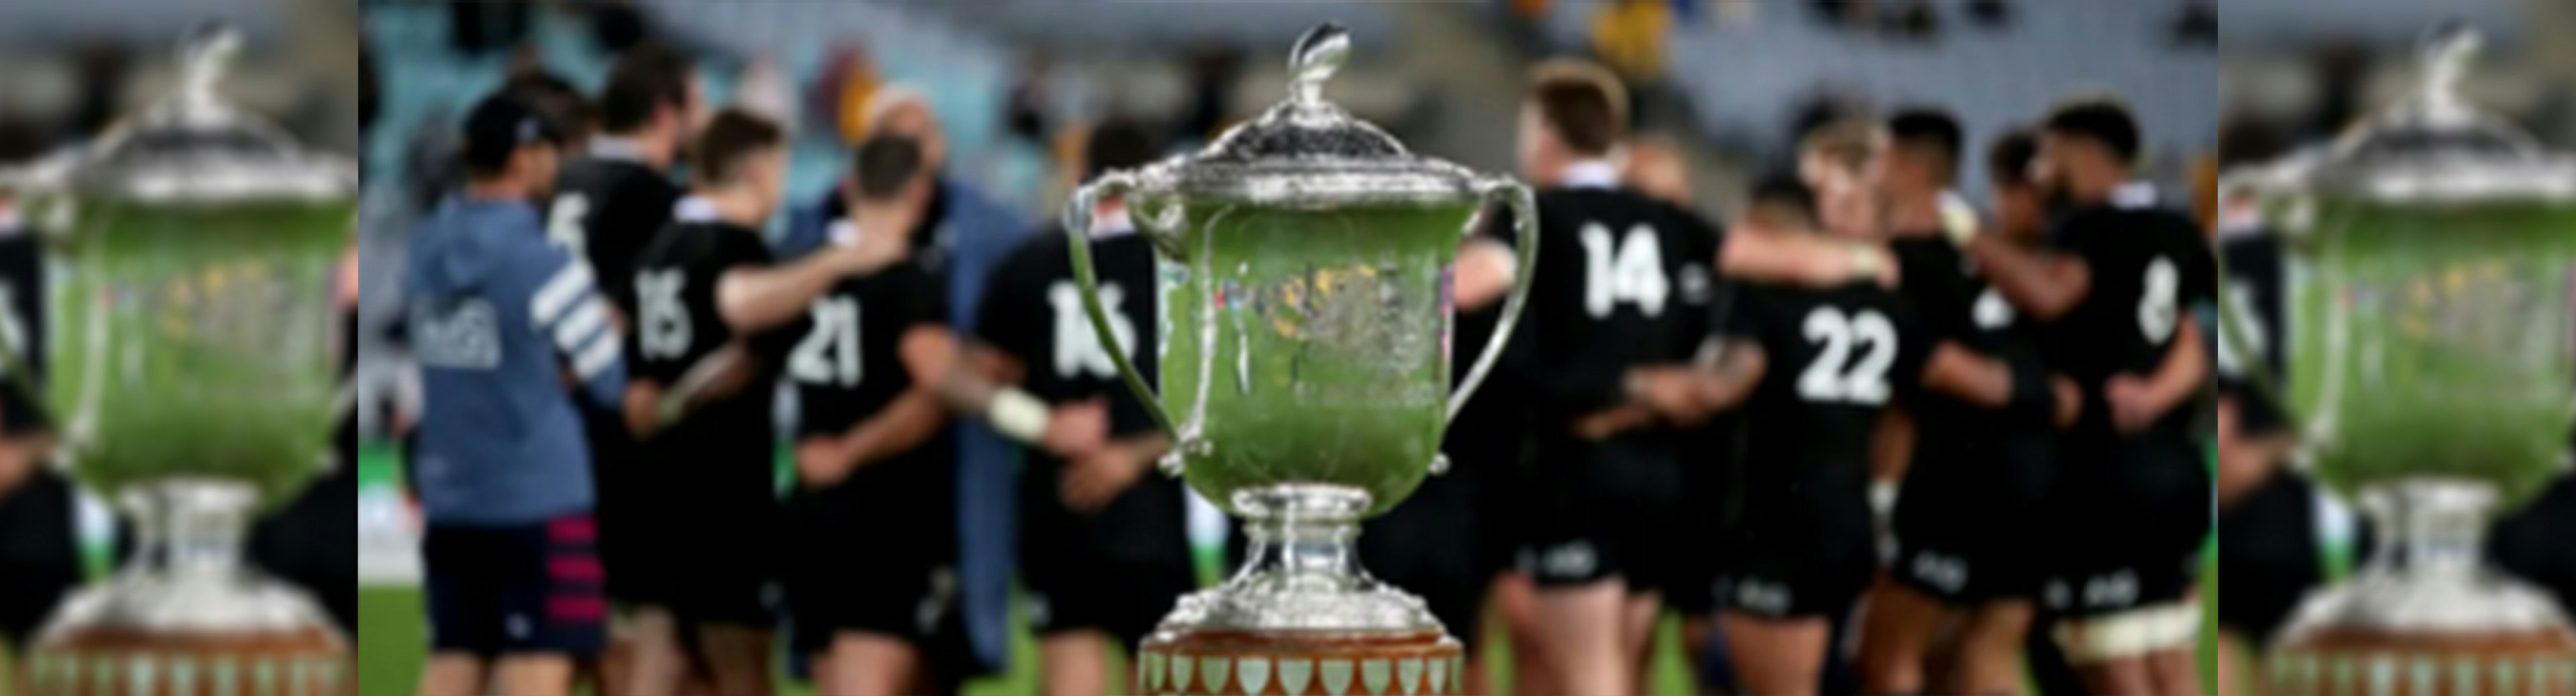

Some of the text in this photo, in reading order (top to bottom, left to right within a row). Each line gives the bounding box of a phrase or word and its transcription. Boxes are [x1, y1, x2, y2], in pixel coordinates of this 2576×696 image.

[1580, 222, 1670, 317] 14
[787, 296, 862, 386] 21
[1796, 306, 1897, 405] 22
